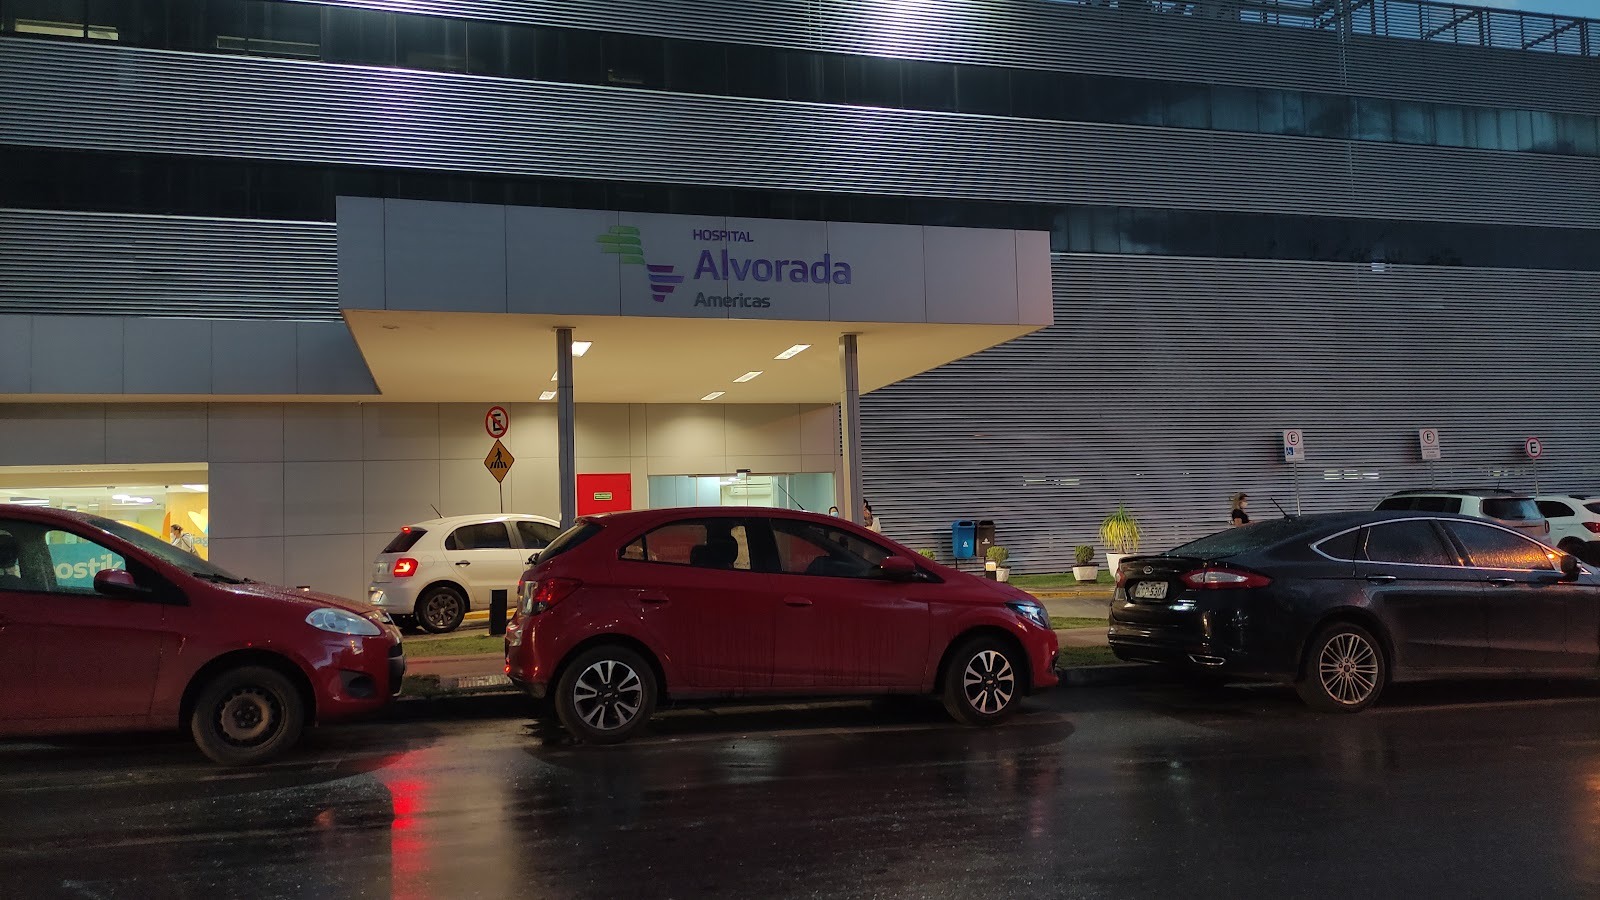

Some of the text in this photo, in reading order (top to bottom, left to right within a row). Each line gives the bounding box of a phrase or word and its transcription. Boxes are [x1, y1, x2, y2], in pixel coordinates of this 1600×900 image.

[693, 229, 753, 242] HOSPITAL
[693, 249, 852, 285] Alvorada
[694, 291, 771, 309] Americas
[1290, 434, 1297, 443] E
[1530, 441, 1538, 454] E
[54, 553, 122, 579] ostik
